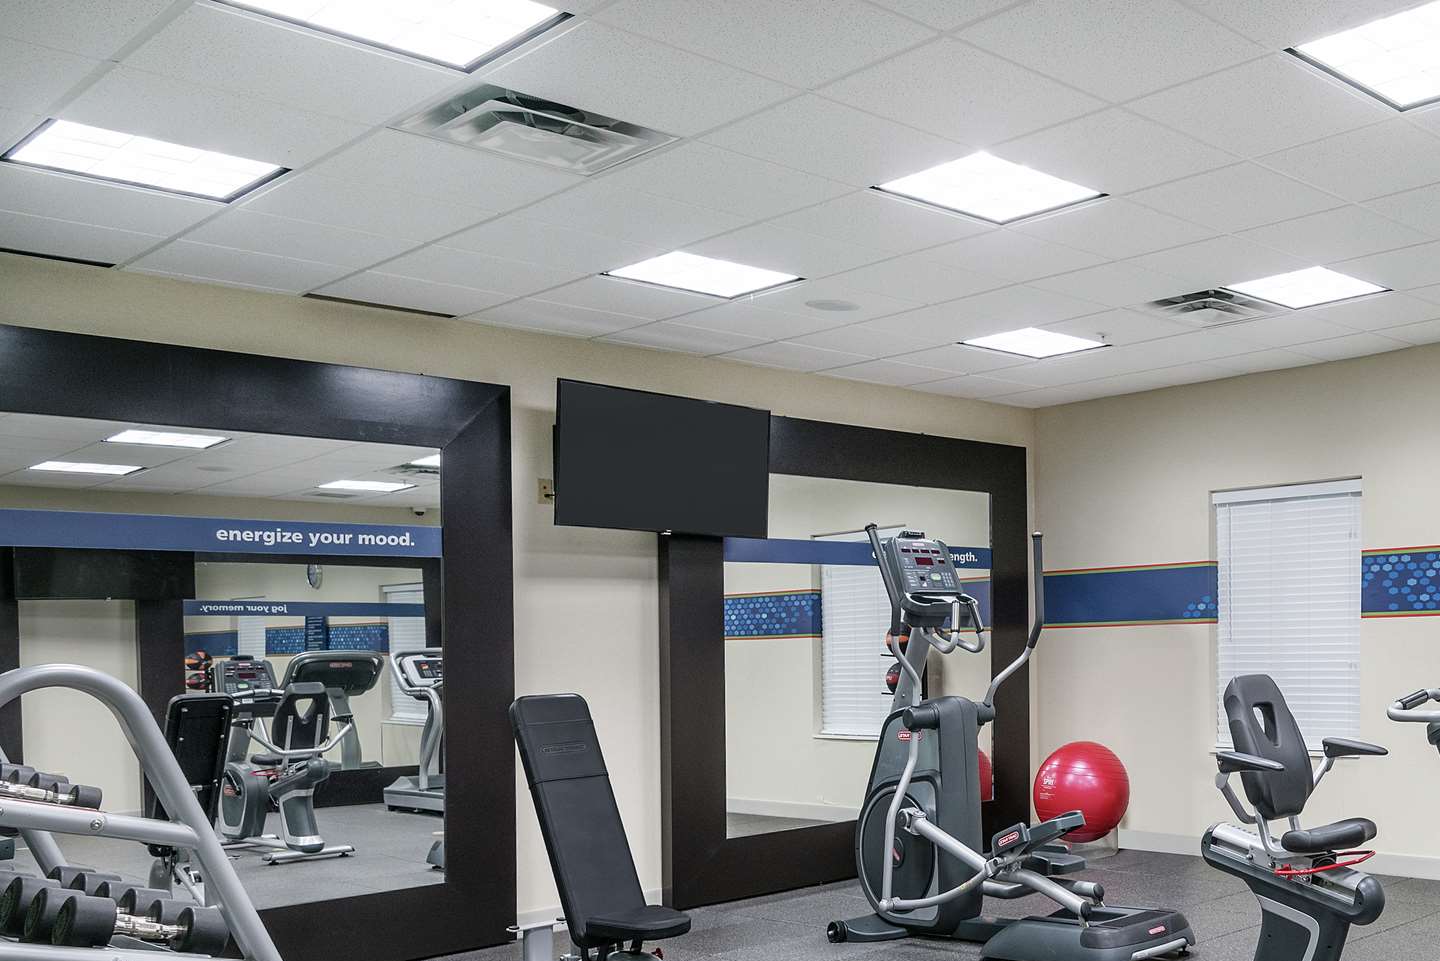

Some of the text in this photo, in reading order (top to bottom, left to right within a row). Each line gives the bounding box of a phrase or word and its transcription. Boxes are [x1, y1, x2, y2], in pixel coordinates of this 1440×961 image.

[216, 528, 415, 547] energize your mood.
[950, 551, 978, 564] ength.
